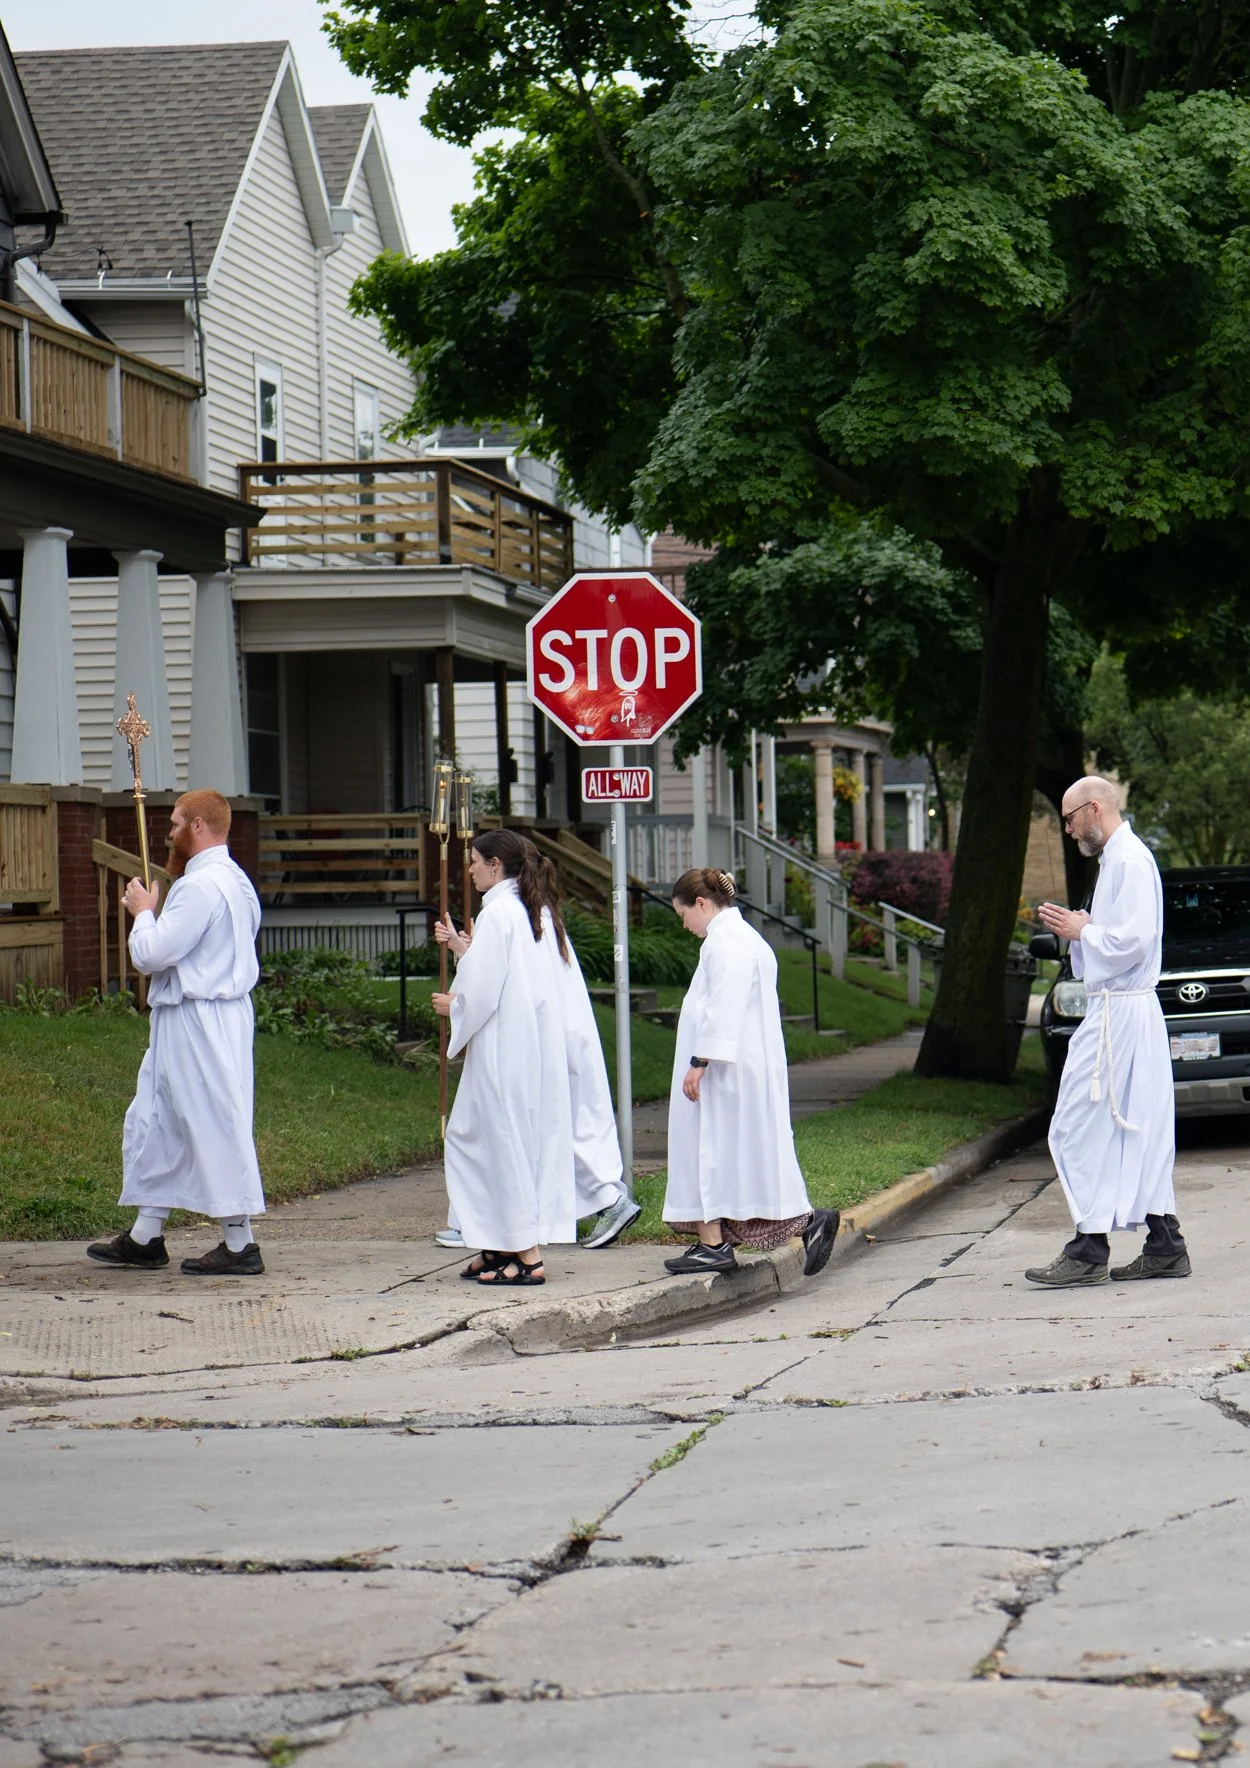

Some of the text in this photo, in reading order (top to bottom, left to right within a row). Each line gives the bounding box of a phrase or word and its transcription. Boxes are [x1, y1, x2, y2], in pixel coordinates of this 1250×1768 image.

[539, 627, 690, 692] STOP
[588, 771, 647, 797] ALL WAY
